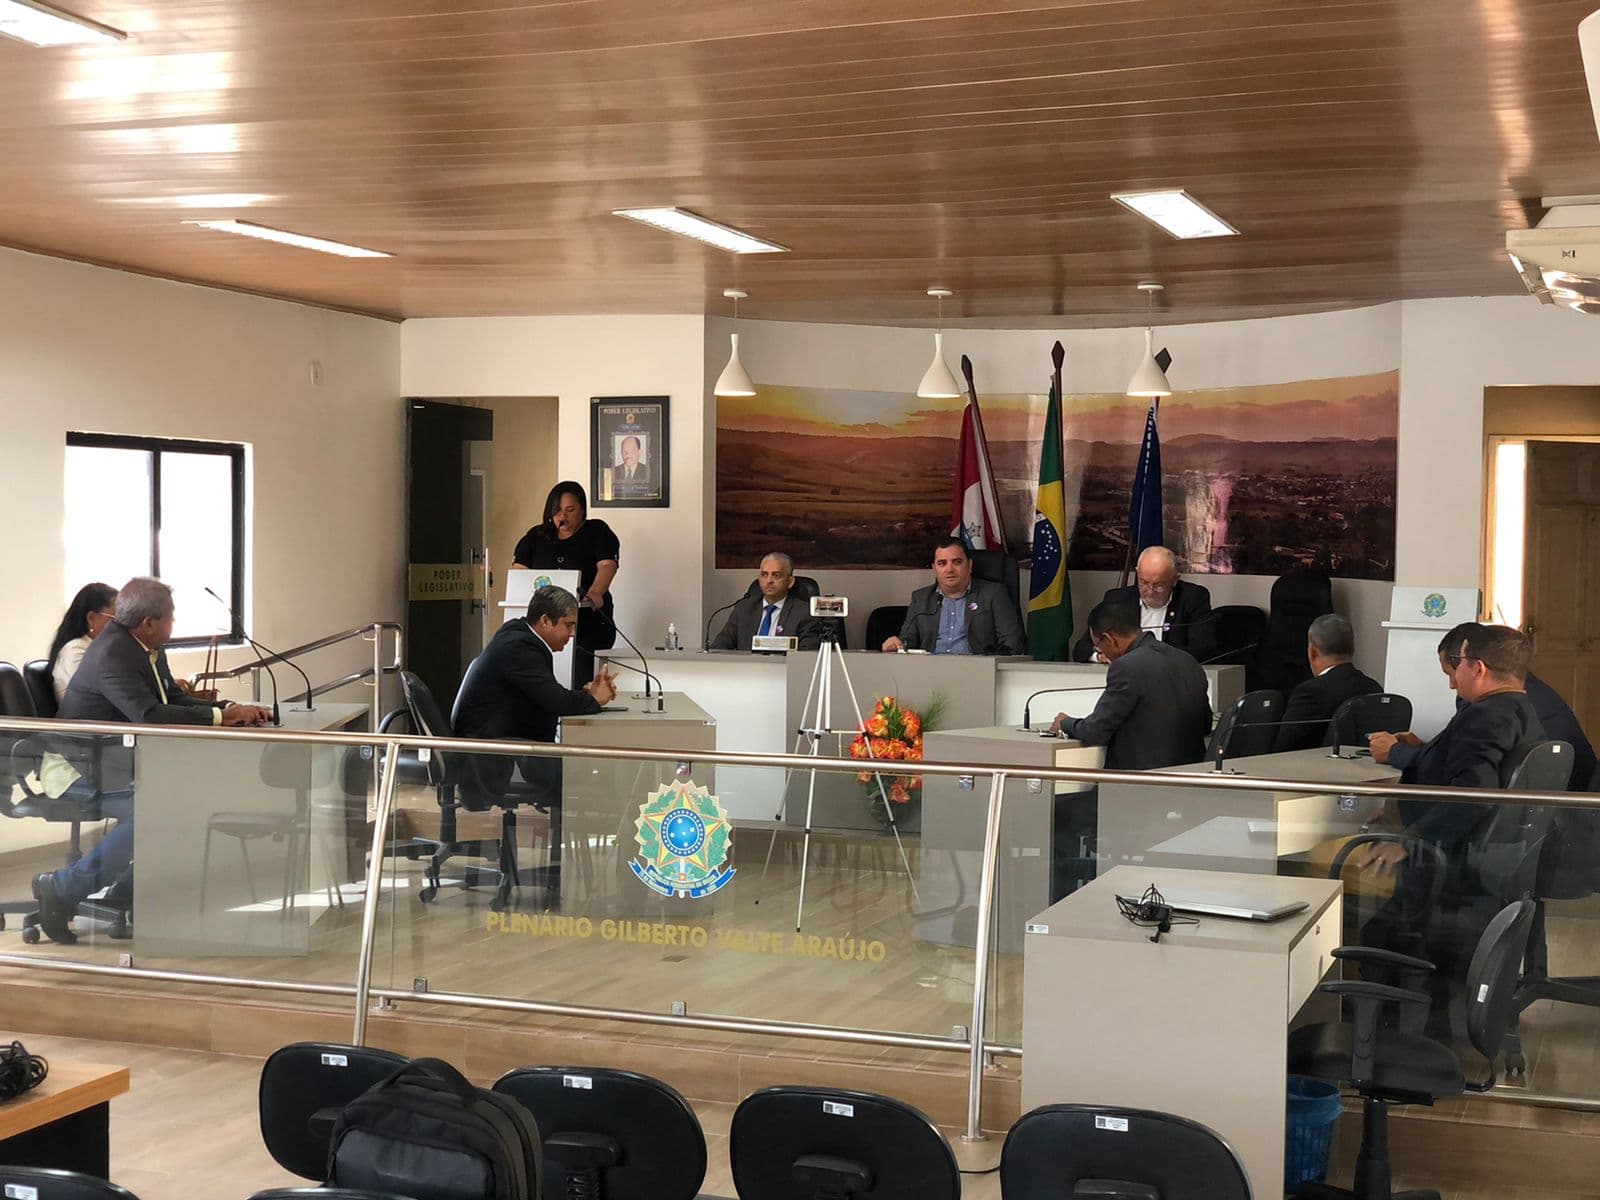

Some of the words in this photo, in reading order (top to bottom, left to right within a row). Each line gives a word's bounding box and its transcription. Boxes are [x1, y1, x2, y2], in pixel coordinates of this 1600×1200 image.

[433, 570, 461, 580] PODER
[419, 582, 474, 593] LEGISLATIVO
[486, 908, 593, 938] PLENÁRIO
[600, 919, 708, 948] GILBERTO
[791, 931, 886, 962] ARAÚJO
